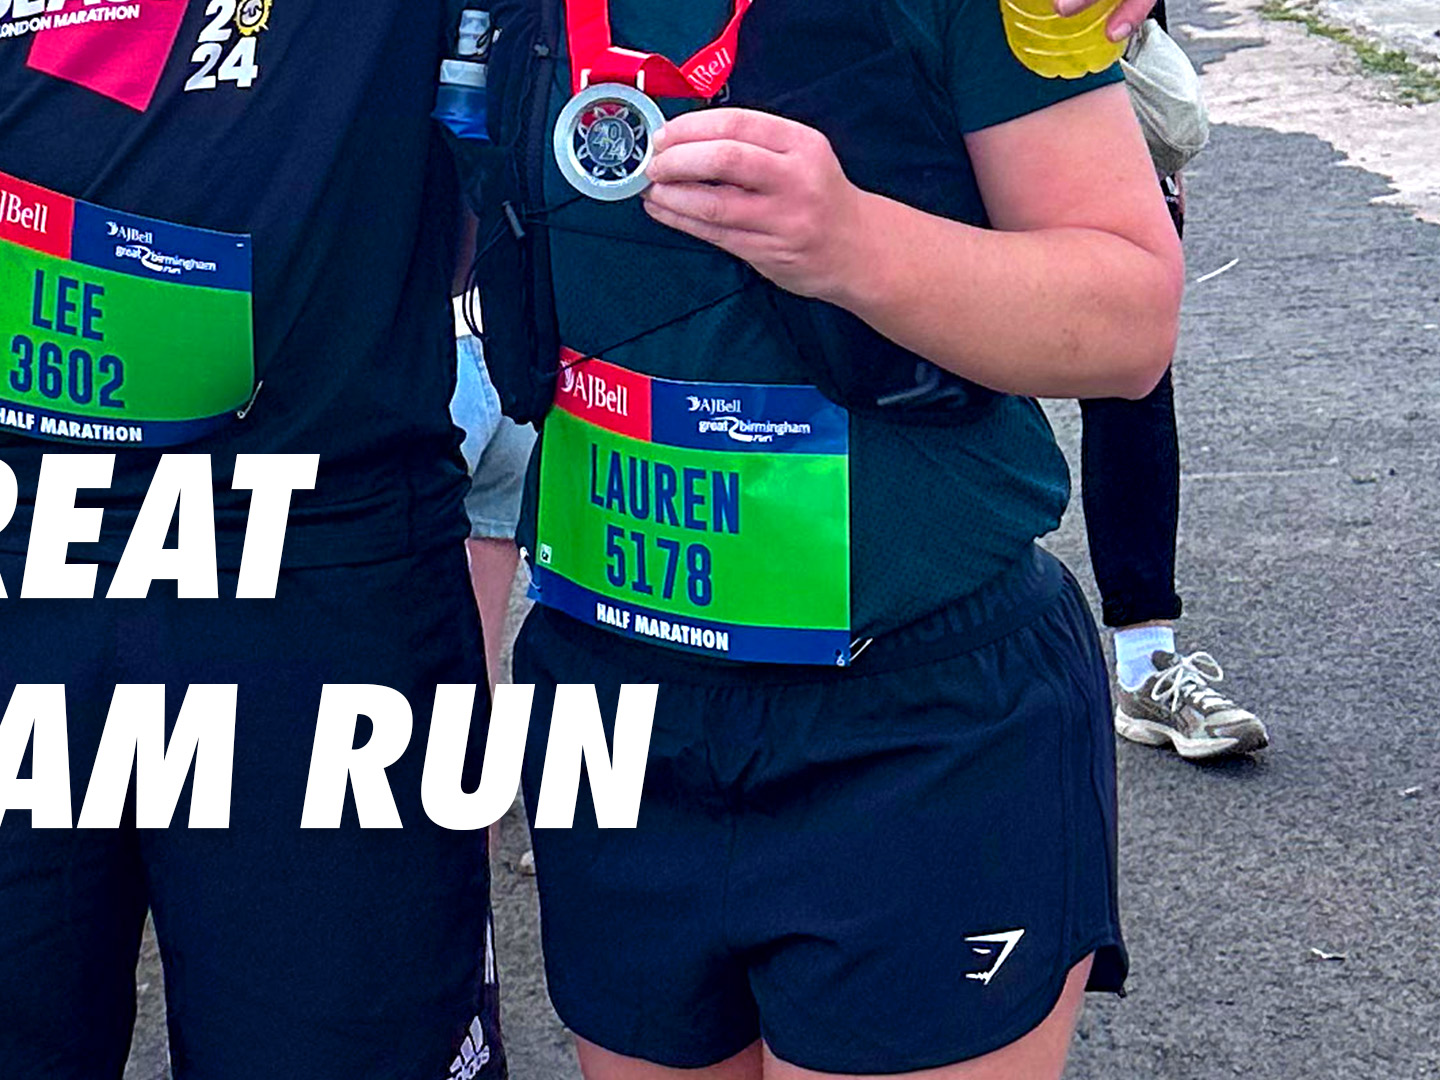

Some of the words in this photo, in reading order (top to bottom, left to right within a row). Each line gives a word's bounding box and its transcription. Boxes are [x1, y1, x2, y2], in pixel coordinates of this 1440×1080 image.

[54, 4, 140, 30] MARATHON
[184, 36, 258, 91] 24
[117, 228, 153, 245] AJBell
[32, 268, 106, 342] LEE
[10, 334, 126, 409] 3602
[572, 370, 629, 417] AJBell
[40, 415, 144, 442] MARATHON
[698, 419, 729, 435] great
[739, 418, 811, 436] birmingham
[699, 399, 742, 414] AJBell
[590, 443, 741, 534] LAUREN
[606, 524, 712, 607] 5178
[596, 602, 630, 631] HALF
[635, 614, 729, 652] MARATHON
